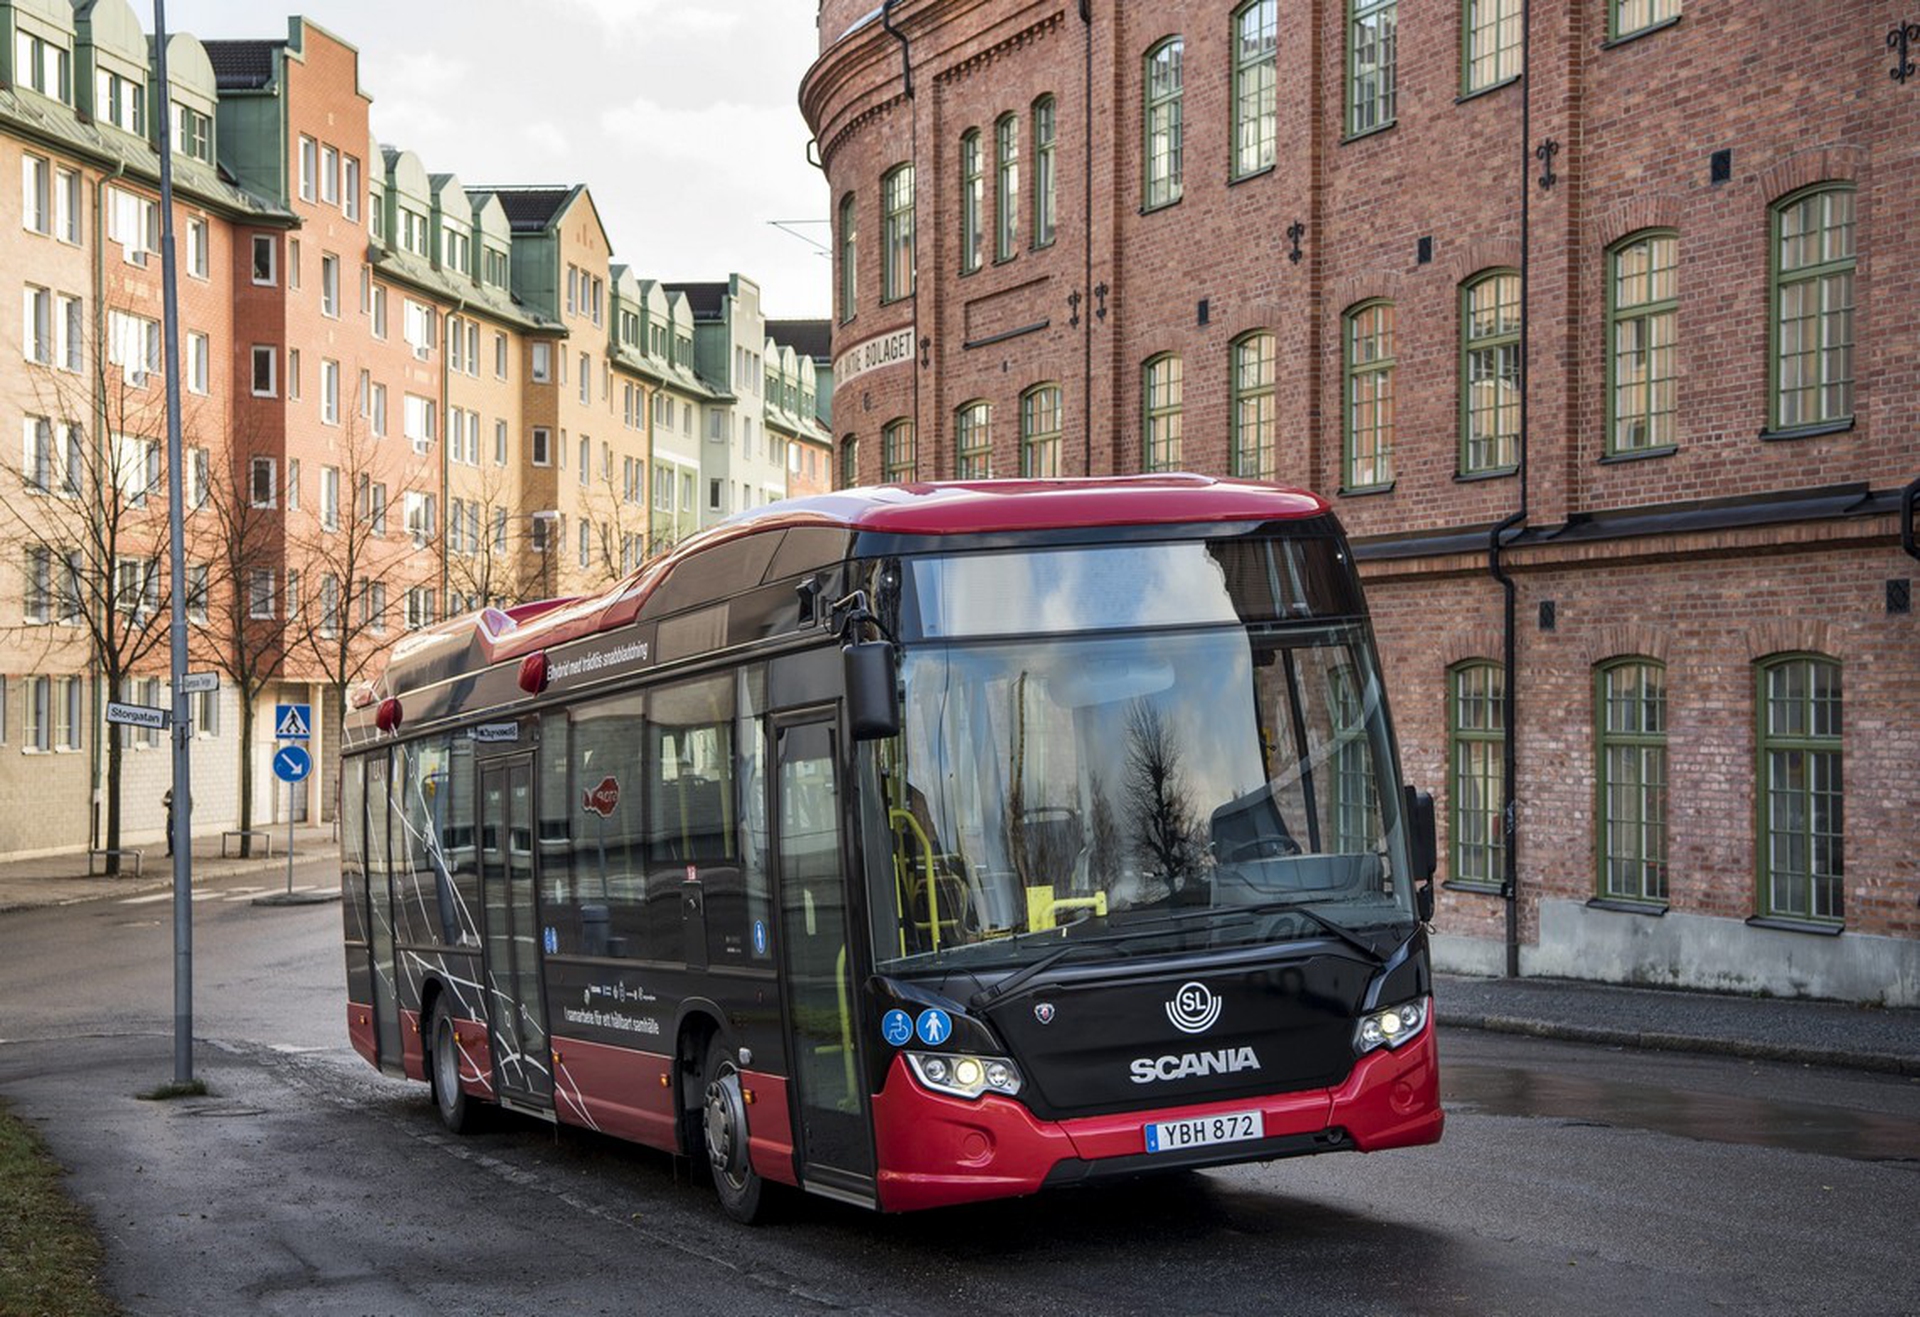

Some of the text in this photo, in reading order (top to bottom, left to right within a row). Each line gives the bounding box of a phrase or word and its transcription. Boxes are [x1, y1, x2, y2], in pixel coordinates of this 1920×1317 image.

[865, 332, 912, 368] BOLAGET
[110, 706, 160, 723] Storgatan
[1181, 991, 1207, 1012] SL
[1129, 1046, 1261, 1084] SCANIA
[1165, 1115, 1255, 1146] YBH 872
